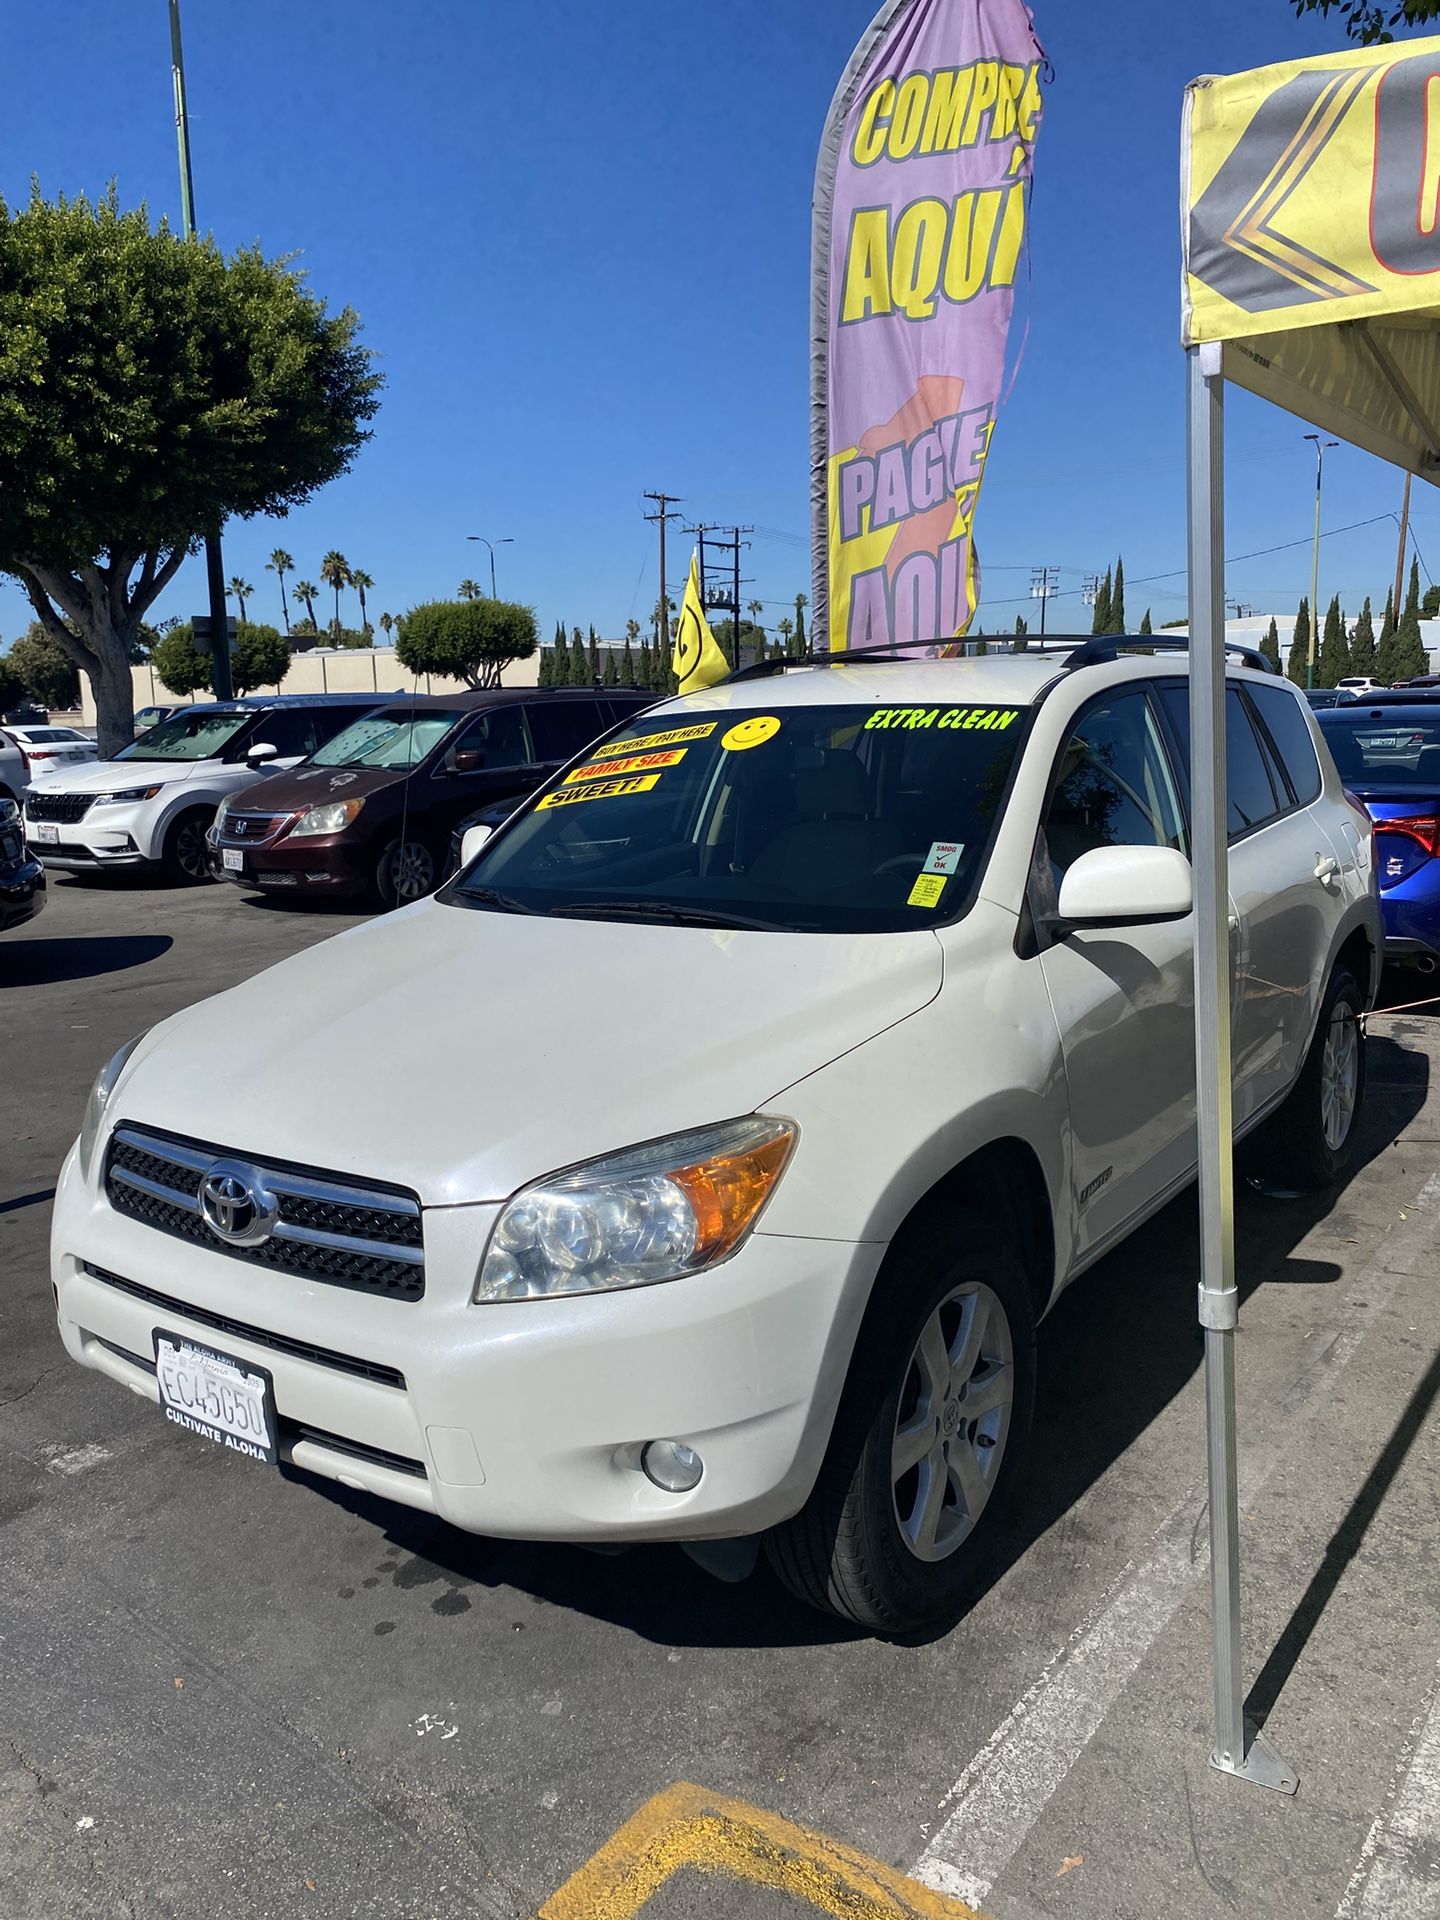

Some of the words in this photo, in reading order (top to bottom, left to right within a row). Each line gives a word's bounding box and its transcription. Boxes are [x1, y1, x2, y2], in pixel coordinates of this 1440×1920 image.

[850, 58, 1043, 169] COMPRE
[838, 142, 1031, 327] AQUÍ
[846, 533, 971, 658] AQU
[864, 709, 940, 730] EXTRA
[937, 709, 1019, 730] CLEAN
[597, 744, 618, 758] BUY
[618, 737, 649, 751] HERE
[656, 731, 679, 744] PAY
[678, 724, 712, 739] HERE
[572, 758, 636, 780] FAMILY
[635, 752, 675, 769] SIZE
[547, 777, 643, 806] SWEET!
[936, 845, 957, 853] SMOG
[933, 861, 947, 869] OK
[193, 1344, 215, 1360] ALOHA
[162, 1365, 262, 1436] EC45G50
[166, 1407, 221, 1443] CULTIVATE
[225, 1435, 267, 1462] ALOHA
